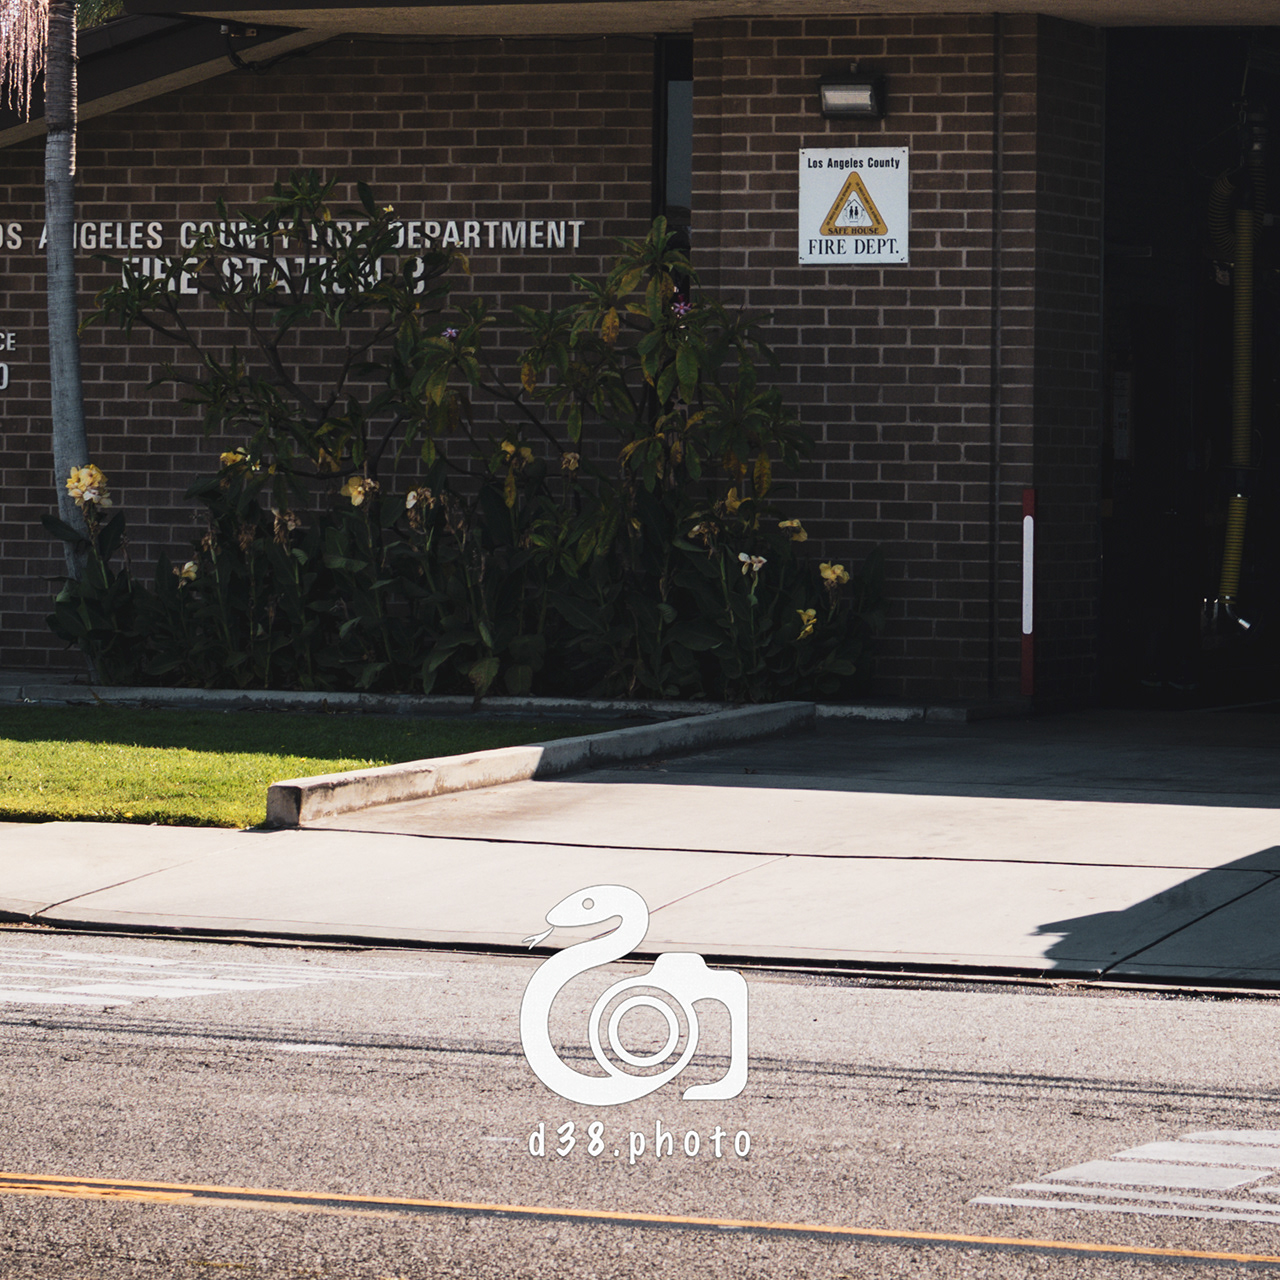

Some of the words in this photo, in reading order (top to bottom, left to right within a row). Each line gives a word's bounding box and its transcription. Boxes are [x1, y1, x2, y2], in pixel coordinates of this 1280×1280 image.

[808, 158, 823, 169] Los
[827, 157, 863, 170] Angeles
[868, 157, 900, 169] County
[38, 222, 163, 250] AGELES
[387, 220, 585, 249] DEPARTMENT
[828, 227, 848, 235] SAFE
[851, 227, 880, 235] HOUSE
[809, 239, 847, 254] FIRE
[855, 238, 899, 254] DEPT.
